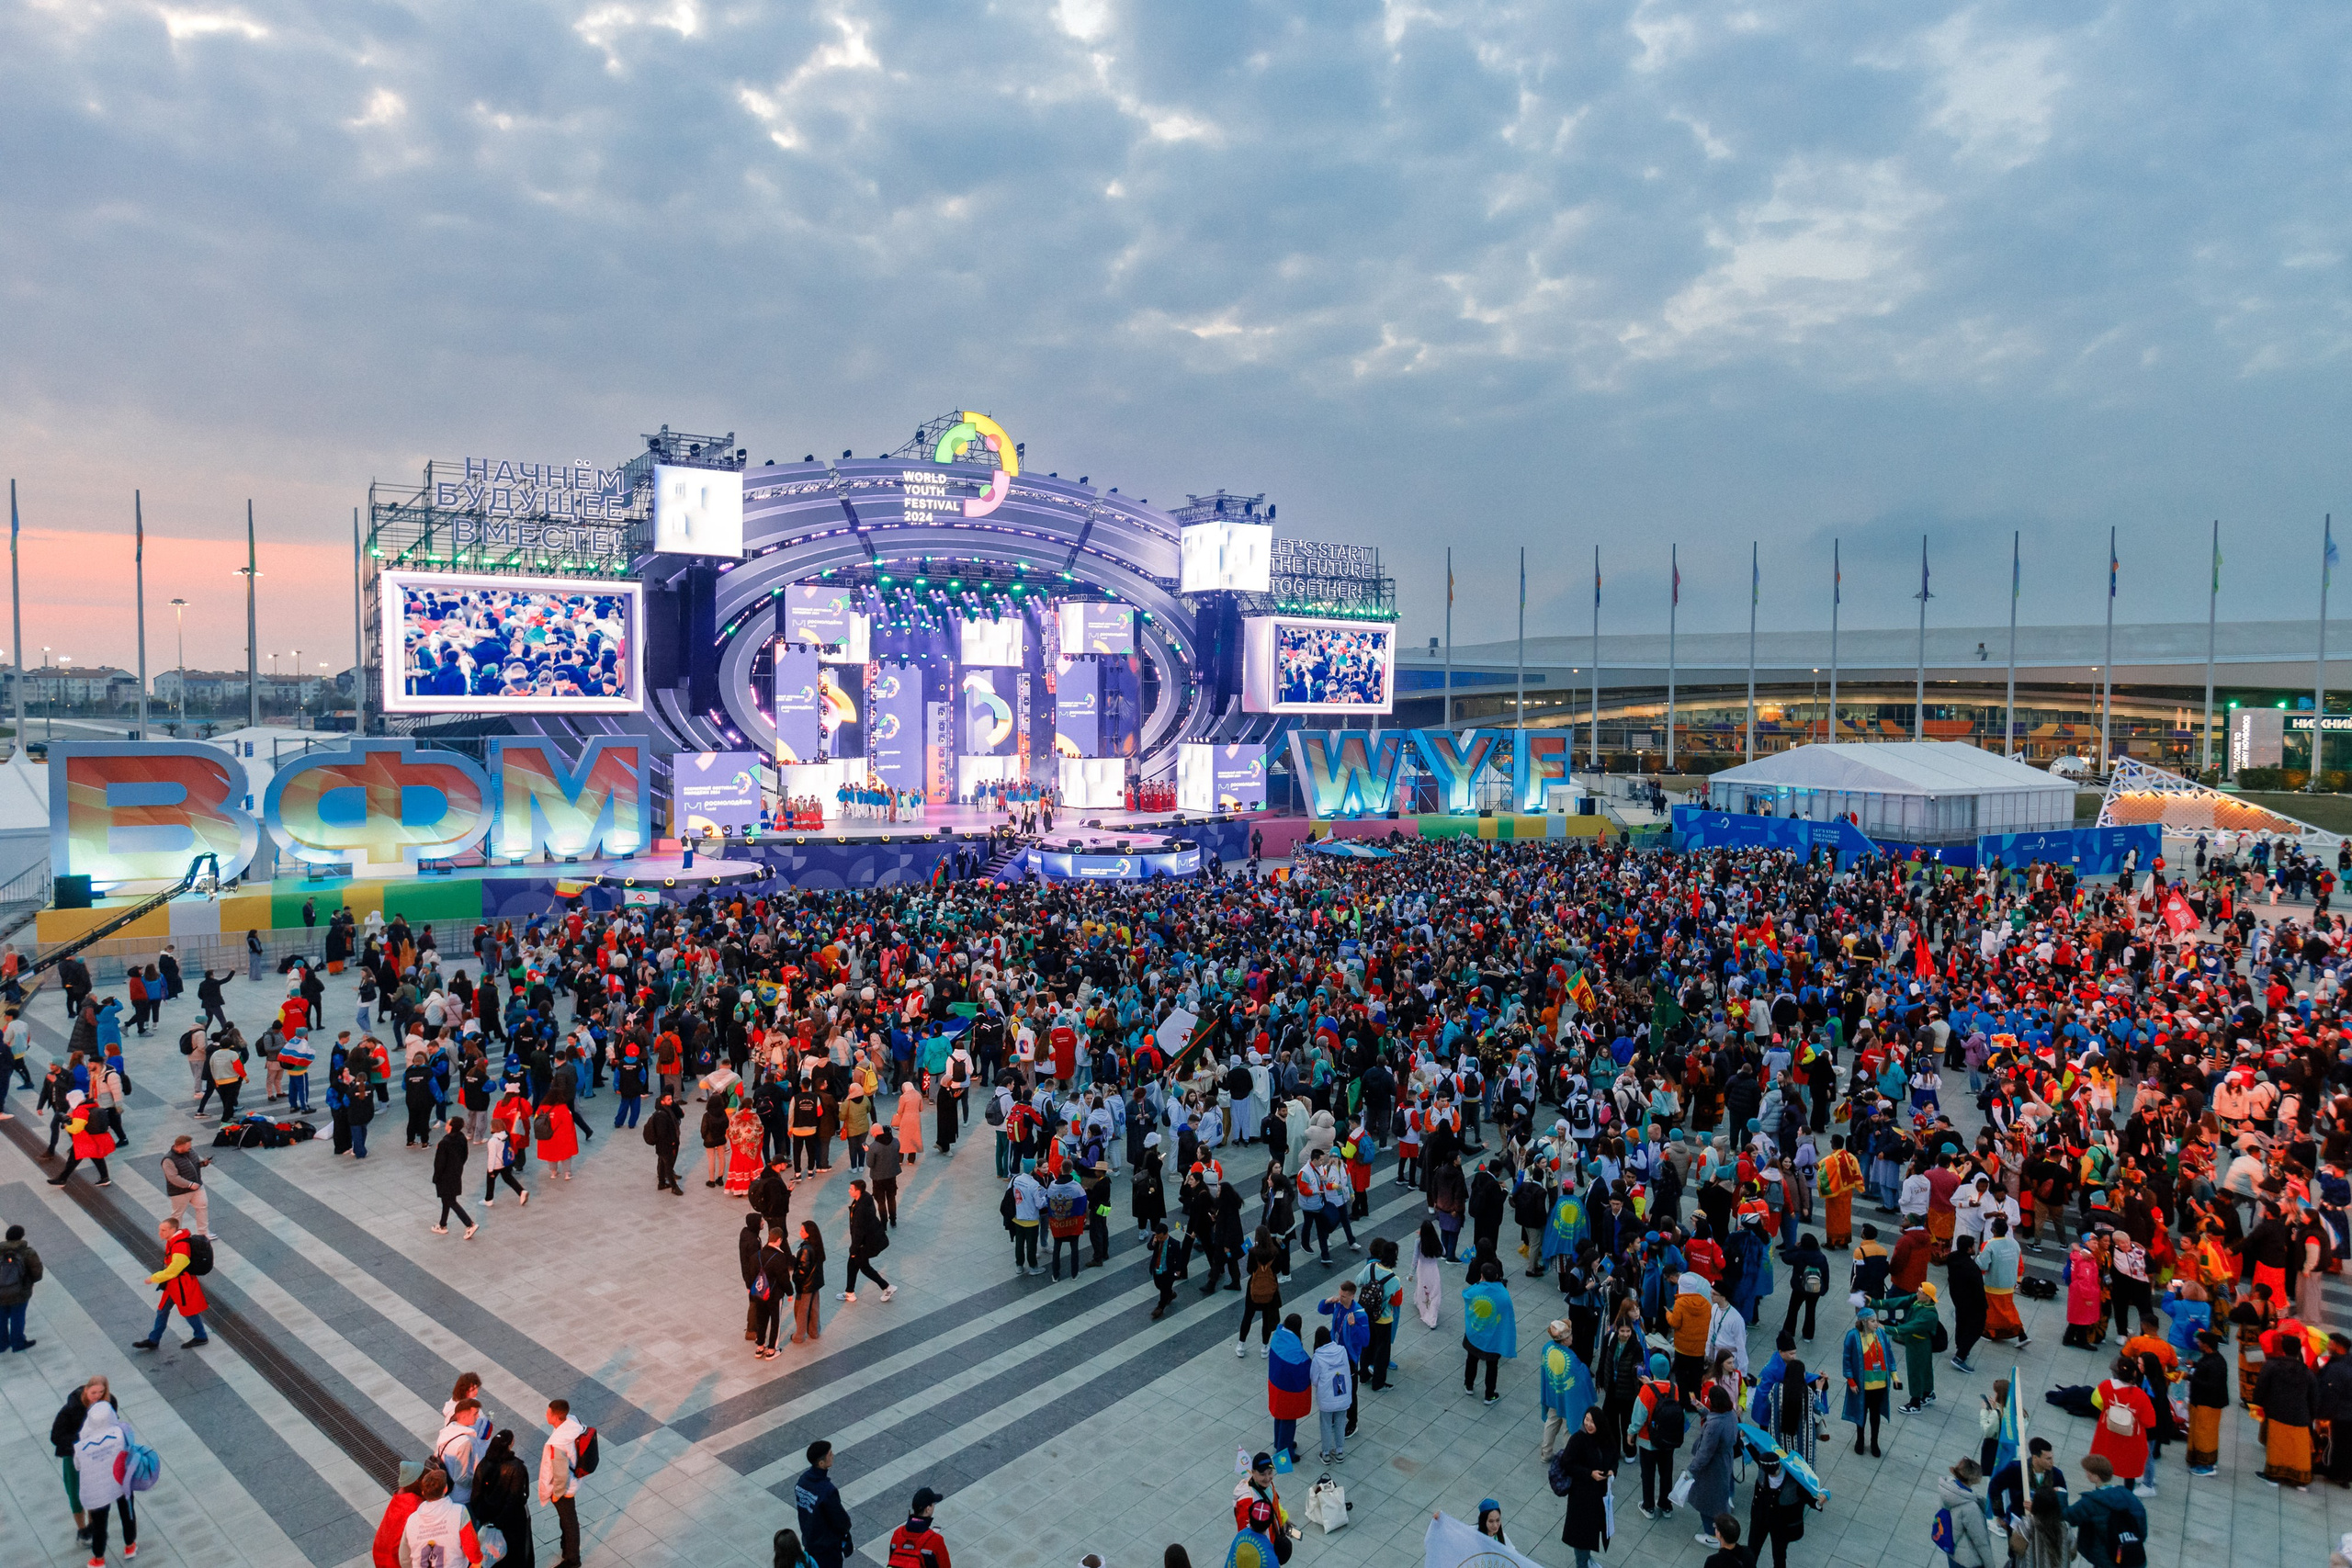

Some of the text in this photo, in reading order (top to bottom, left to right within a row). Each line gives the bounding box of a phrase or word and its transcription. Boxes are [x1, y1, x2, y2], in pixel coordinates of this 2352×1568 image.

[465, 456, 625, 494] НАЧНЁМ
[903, 471, 947, 484] WORLD
[436, 481, 625, 522] БУДУЩЕЕ
[903, 484, 945, 497] YOUTH
[904, 497, 960, 512] FESTIVAL
[904, 511, 933, 523] 2024
[453, 517, 621, 555] ВМЕСТЕ!
[1318, 542, 1373, 561] START
[1270, 555, 1372, 579] THE FUTURE
[1269, 577, 1362, 599] TOGETHER!
[2233, 731, 2242, 740] TO
[1287, 728, 1572, 820] WYF
[49, 734, 650, 892] ВФМ
